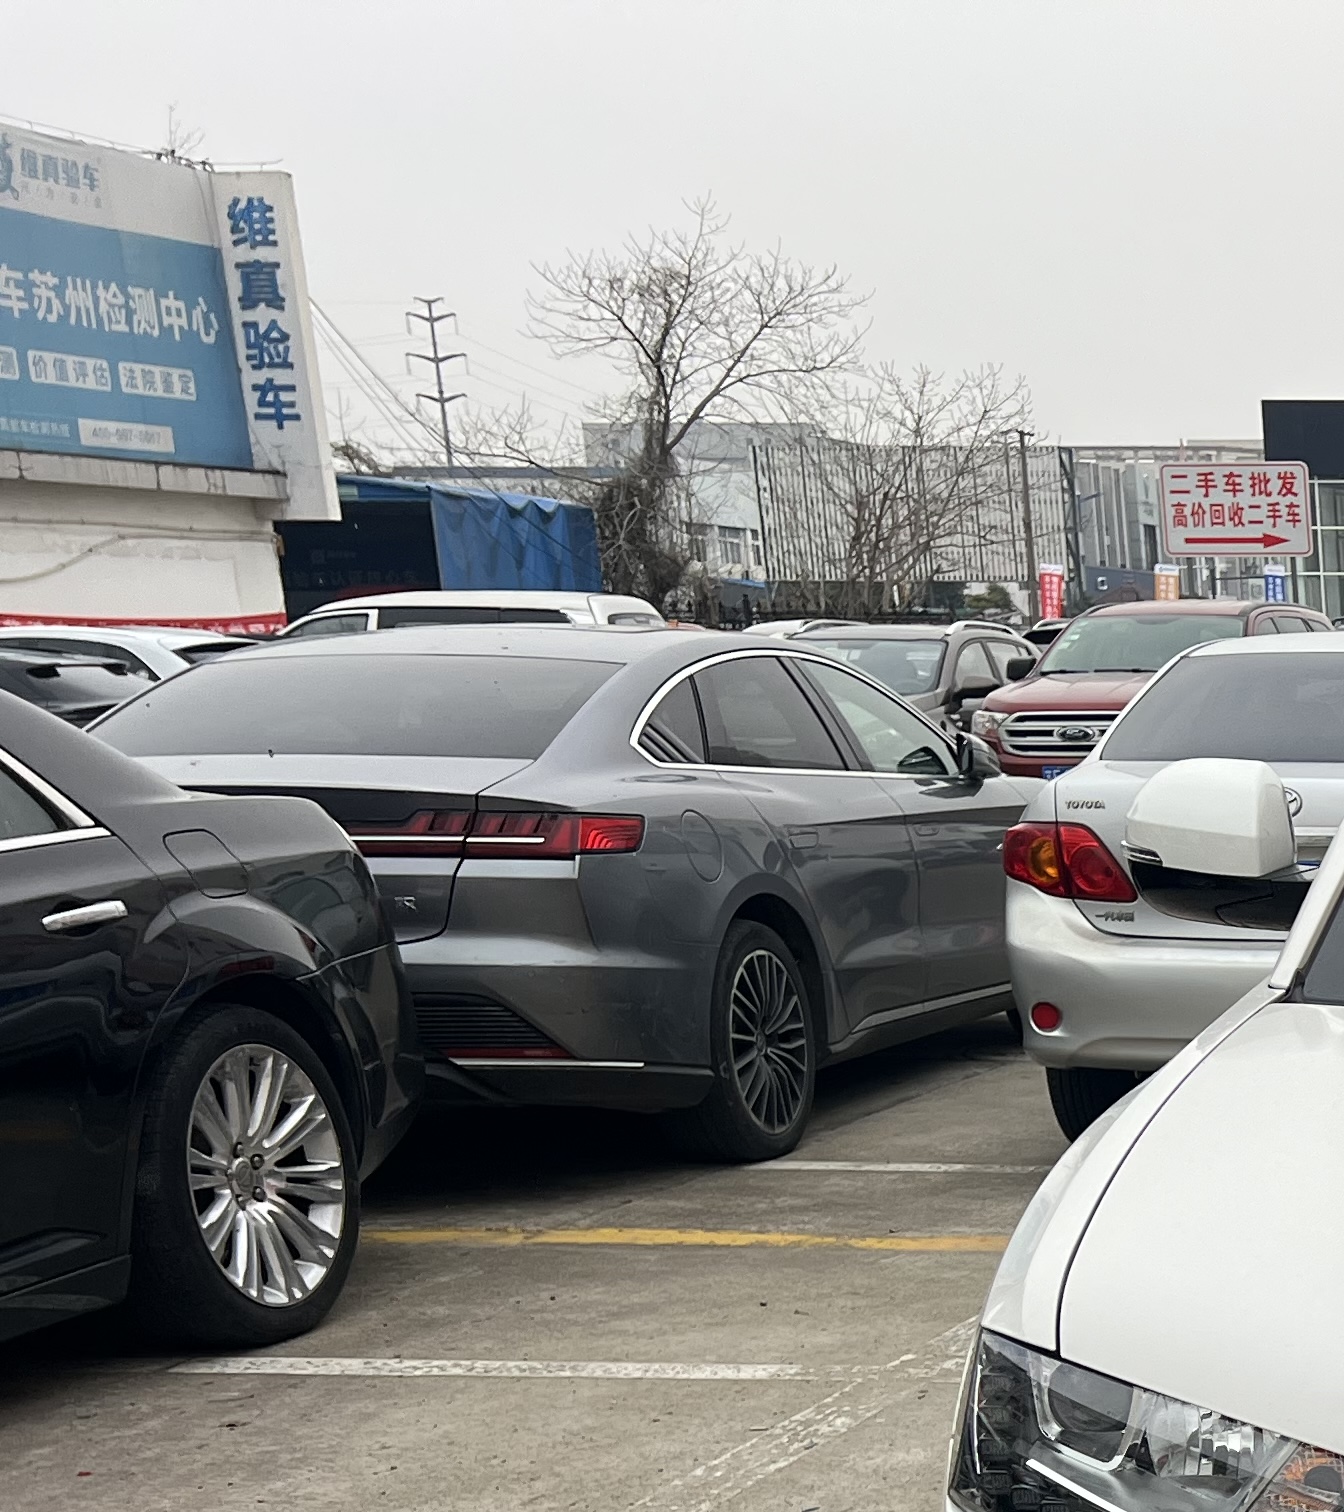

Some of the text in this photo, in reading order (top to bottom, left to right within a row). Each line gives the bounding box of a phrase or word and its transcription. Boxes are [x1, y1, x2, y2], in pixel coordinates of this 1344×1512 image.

[0, 263, 220, 345] 车苏州检测中心
[227, 196, 301, 430] 维真验车
[32, 354, 109, 388] 价值评估
[1169, 471, 1299, 498] 二手车批发
[1171, 502, 1302, 529] 高价回收二手车
